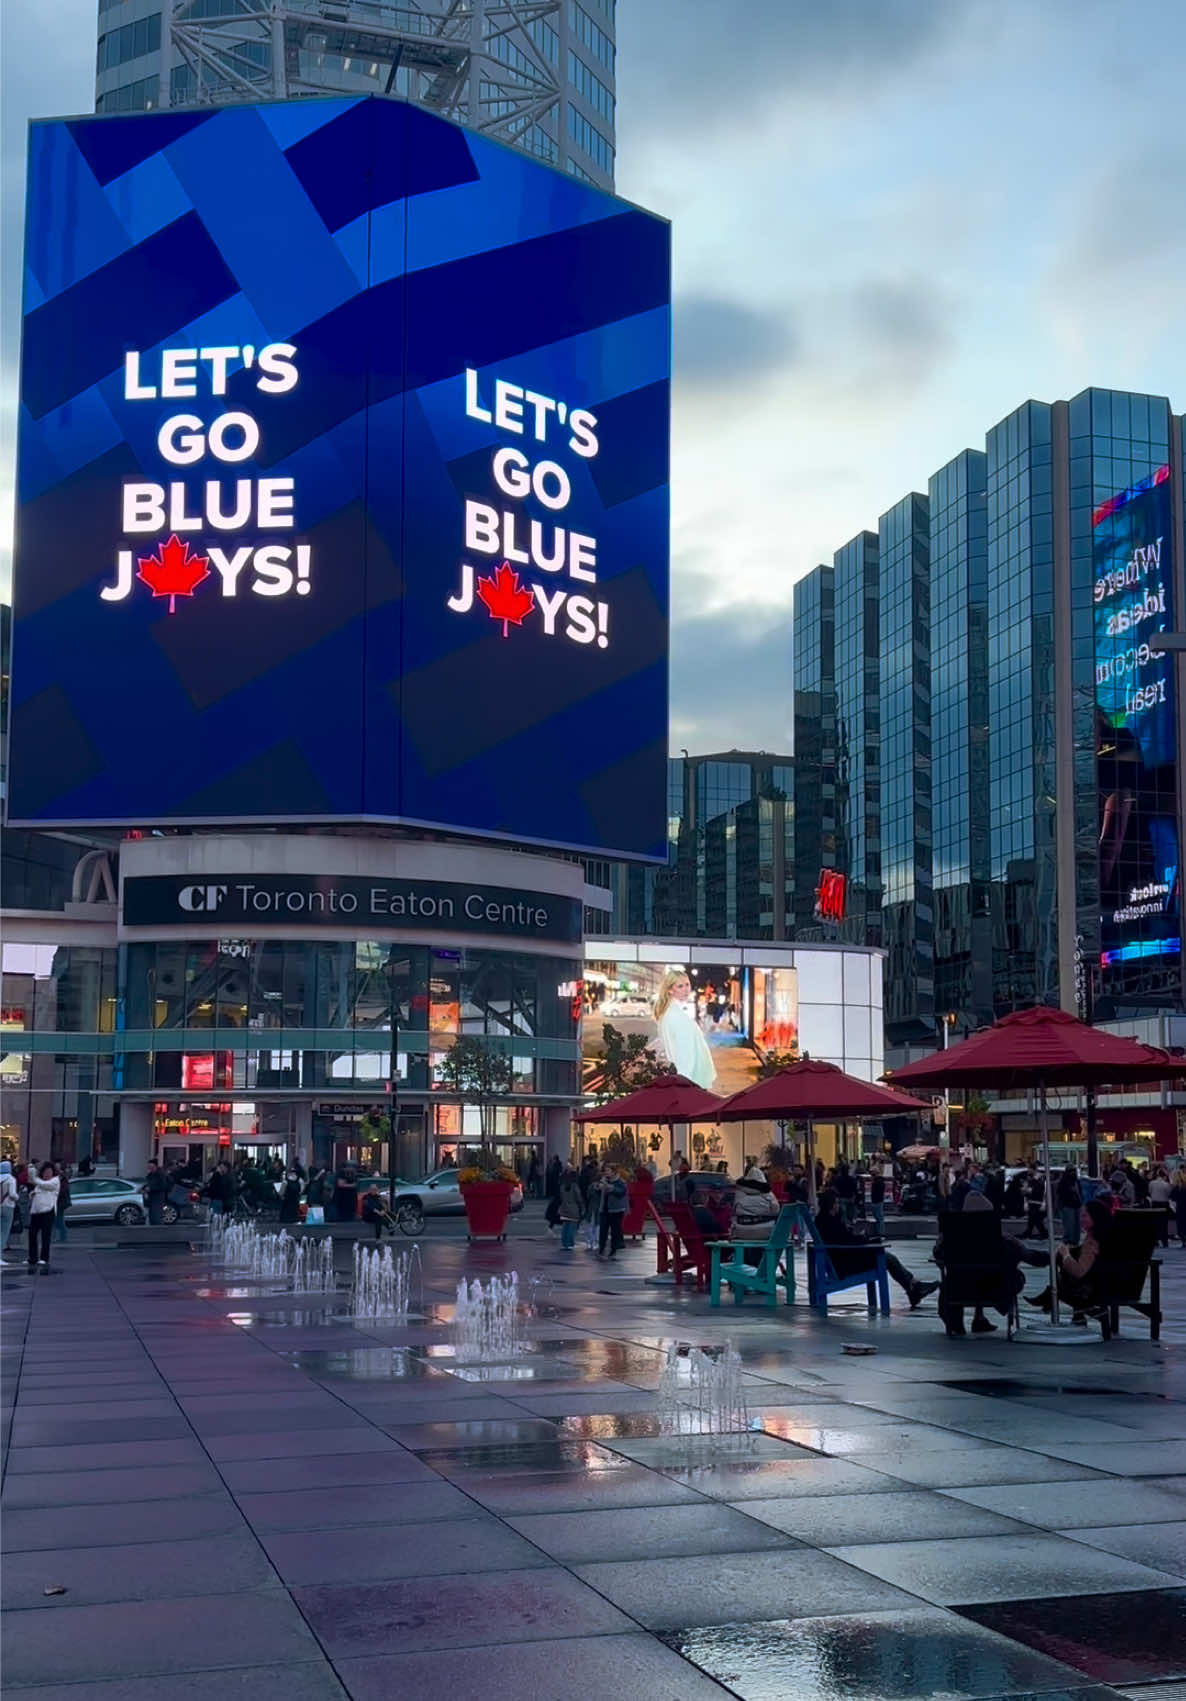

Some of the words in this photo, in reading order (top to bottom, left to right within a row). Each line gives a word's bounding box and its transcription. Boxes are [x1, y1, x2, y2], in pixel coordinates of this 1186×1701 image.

[124, 343, 299, 401] LET'S
[157, 411, 260, 465] GO
[465, 366, 599, 458] LET'S
[122, 477, 294, 533] BLUE
[493, 446, 571, 510] GO
[465, 499, 597, 584] BLUE
[177, 885, 228, 912] CF
[236, 884, 358, 913] Toronto
[370, 888, 454, 918] Eaton
[464, 894, 548, 928] Centre
